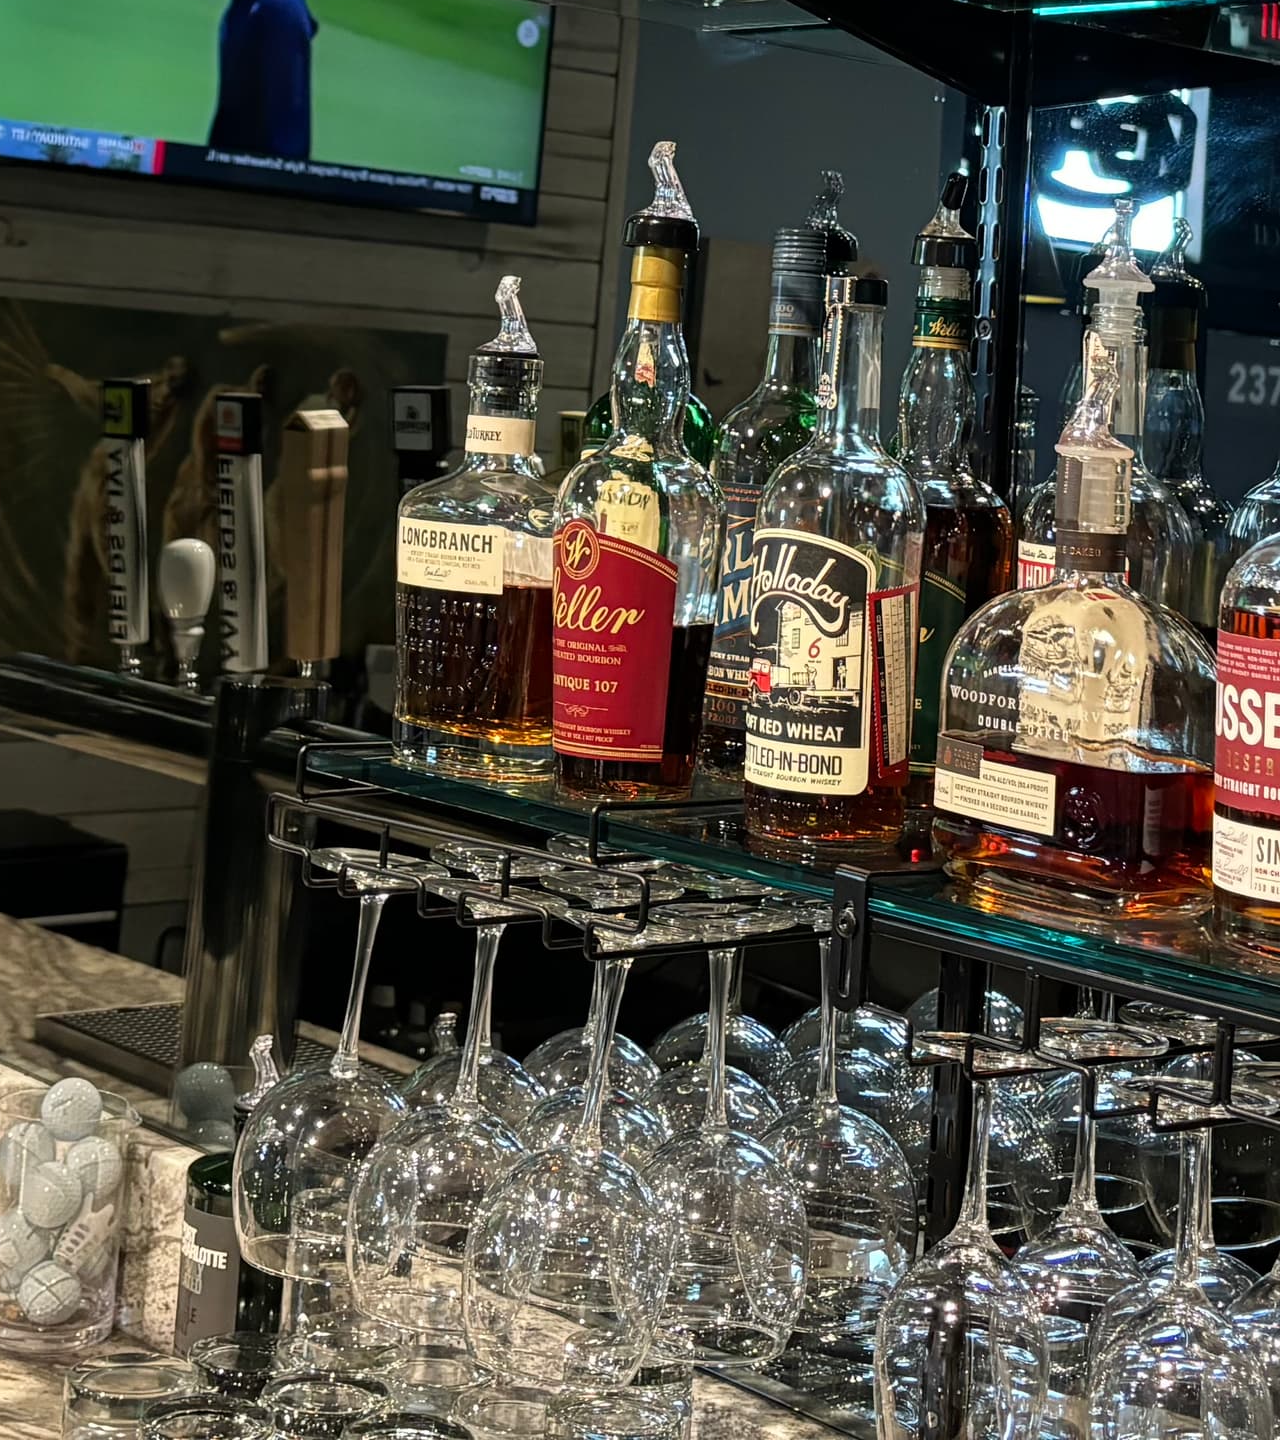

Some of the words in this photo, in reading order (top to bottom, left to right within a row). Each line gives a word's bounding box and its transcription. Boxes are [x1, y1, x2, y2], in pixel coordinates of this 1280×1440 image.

[402, 525, 493, 554] LONGBRANCH
[752, 544, 850, 609] Holladay
[567, 640, 607, 653] ORIGINAL
[808, 638, 821, 659] 6
[577, 653, 621, 665] BOURBON
[594, 680, 619, 694] 107
[759, 716, 782, 735] RED
[787, 721, 844, 743] WHEAT
[978, 714, 1020, 733] DOUBLE
[746, 742, 842, 776] TTLED-IN-BOND
